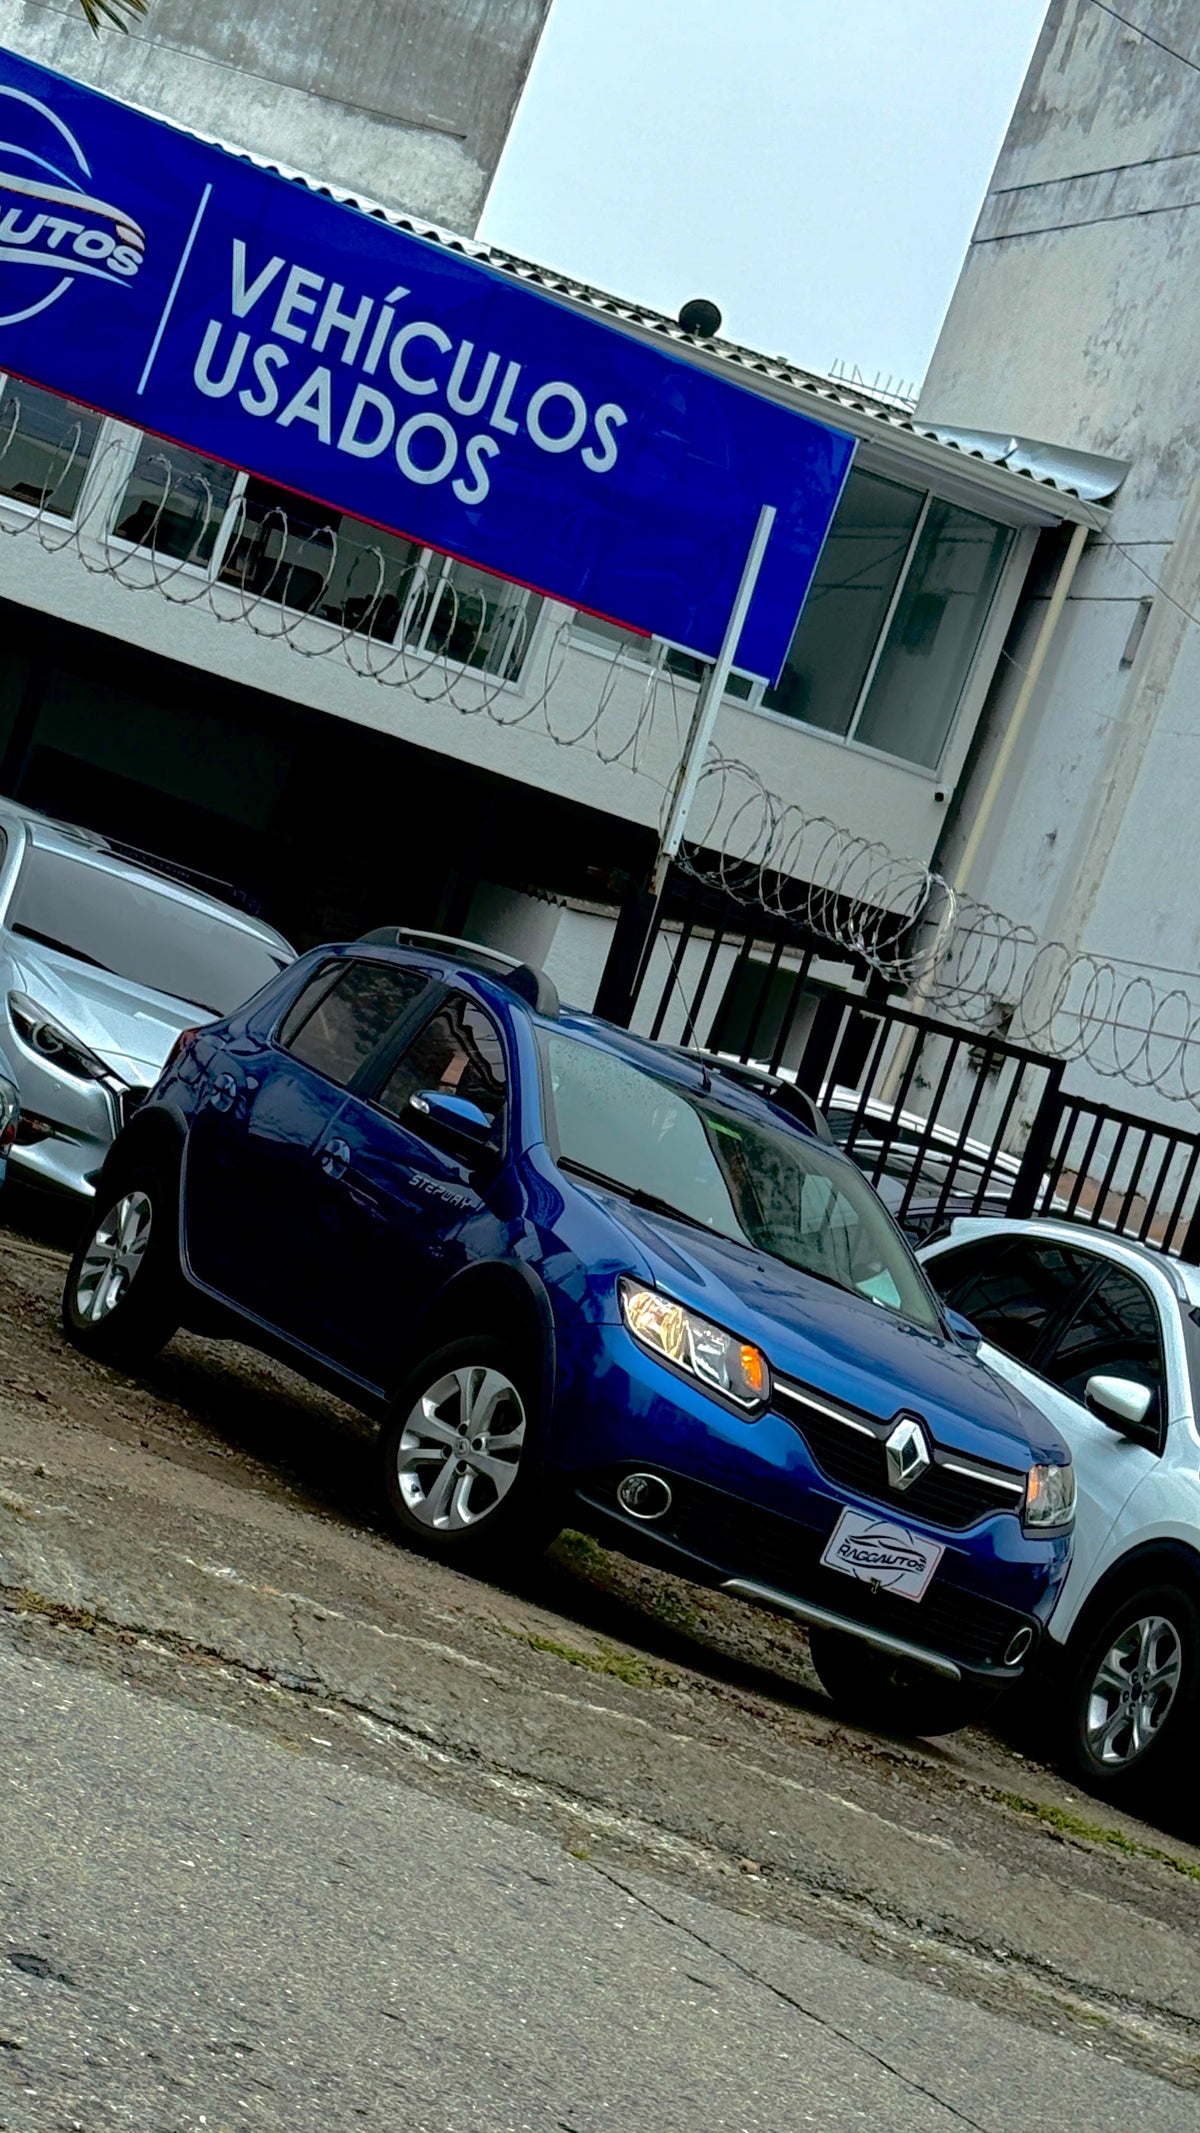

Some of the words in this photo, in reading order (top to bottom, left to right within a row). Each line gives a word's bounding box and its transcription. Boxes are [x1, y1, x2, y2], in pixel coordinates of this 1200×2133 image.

[0, 205, 144, 276] UTOS
[231, 238, 628, 473] VEHÍCULOS
[193, 319, 500, 505] USADOS
[408, 1174, 473, 1209] STEPWAY
[837, 1543, 926, 1573] RAGGAUTOS
